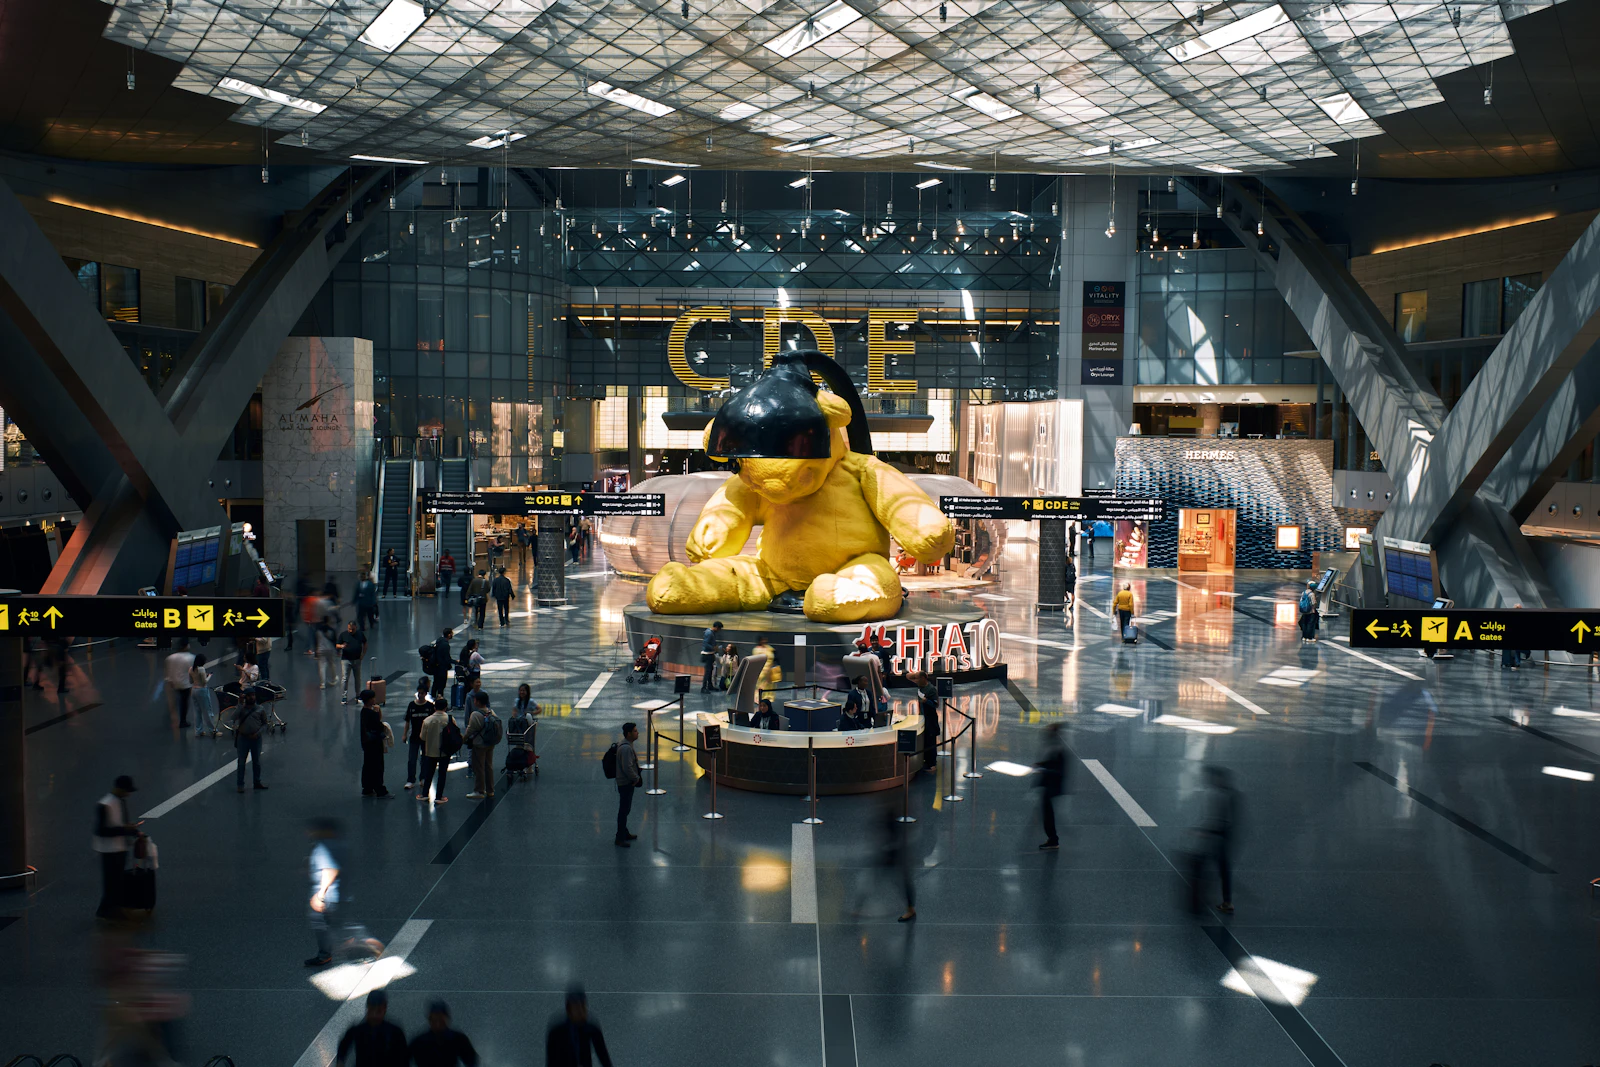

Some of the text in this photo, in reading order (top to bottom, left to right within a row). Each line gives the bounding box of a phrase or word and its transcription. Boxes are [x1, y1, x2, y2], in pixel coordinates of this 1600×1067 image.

[280, 414, 338, 422] AL MAHA
[536, 496, 560, 505] CDE
[1045, 501, 1068, 510] CDE
[132, 609, 157, 618] بوابات
[164, 608, 181, 628] B
[1454, 621, 1473, 640] A
[1480, 621, 1505, 631] بوابات
[964, 618, 1000, 668] 10
[890, 653, 972, 675] turns
